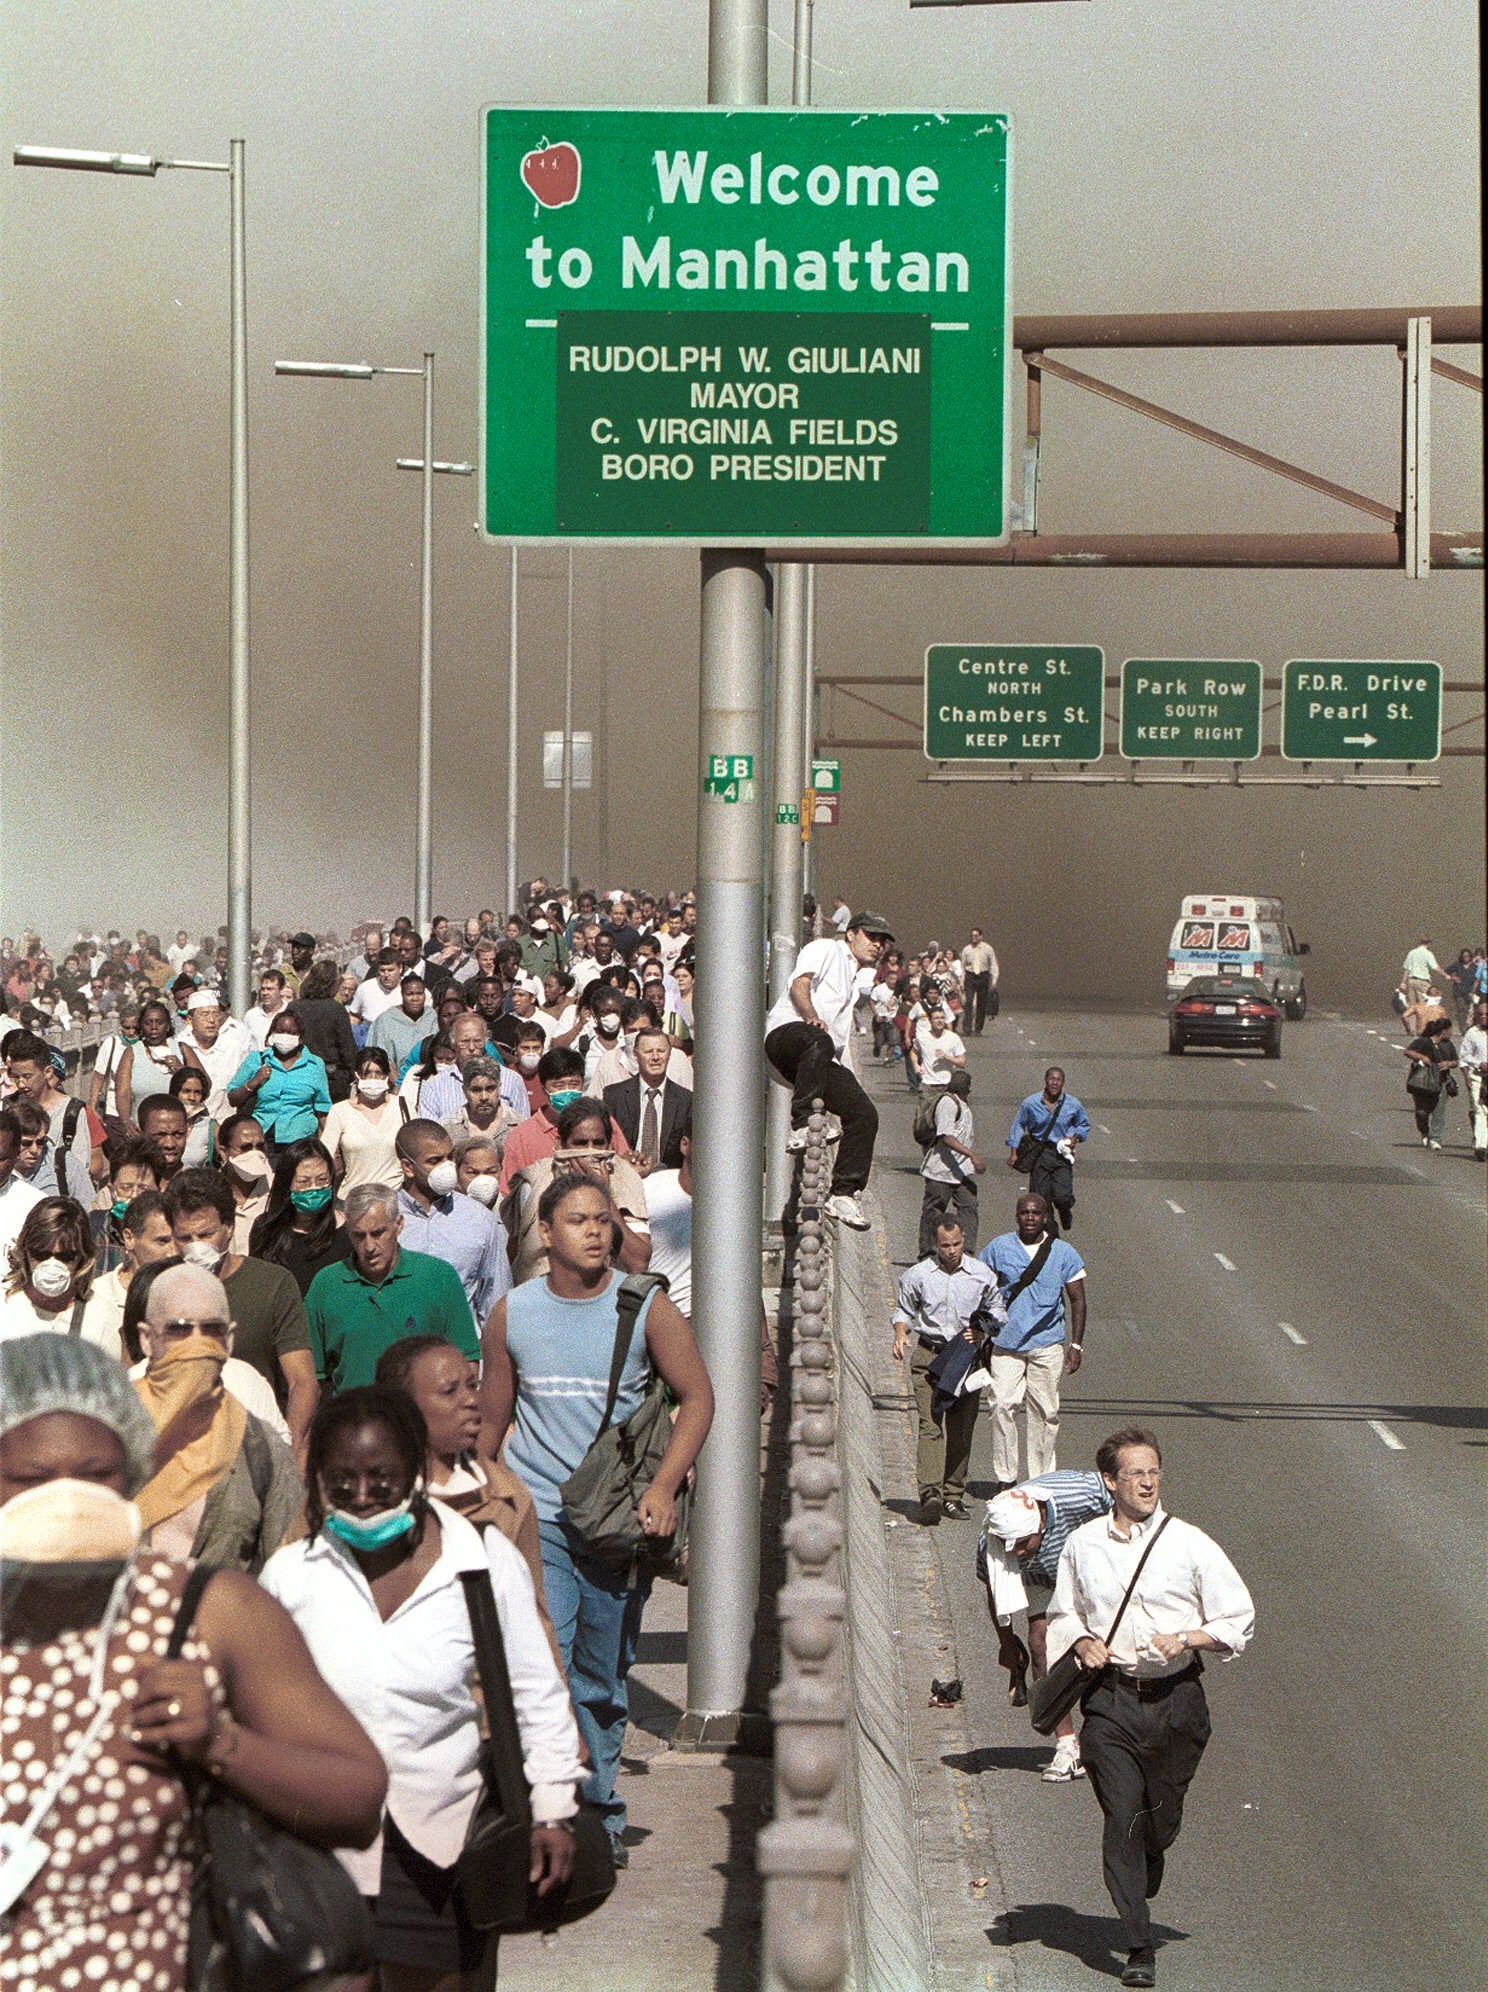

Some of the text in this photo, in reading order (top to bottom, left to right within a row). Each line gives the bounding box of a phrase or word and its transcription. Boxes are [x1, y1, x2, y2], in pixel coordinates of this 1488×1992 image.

[654, 151, 939, 207] Welcome
[526, 236, 969, 292] to Manhattan
[570, 346, 920, 373] RUDOLPH W. GIULIANI
[690, 382, 799, 409] MAYOR
[591, 418, 898, 445] C. VIRGINIA FIELDS
[602, 454, 886, 481] BORO PRESIDENT
[958, 658, 1071, 675] Centre St.
[987, 681, 1042, 695] NORTH
[1136, 678, 1247, 695] Park Row
[1297, 674, 1428, 692] F.D.R. Drive
[938, 706, 1089, 723] Chambers St.
[1164, 704, 1218, 717] SOUTH
[1309, 702, 1413, 720] Pearl St.
[965, 733, 1062, 747] KEEP LEFT
[1137, 726, 1244, 740] KEEP RIGHT
